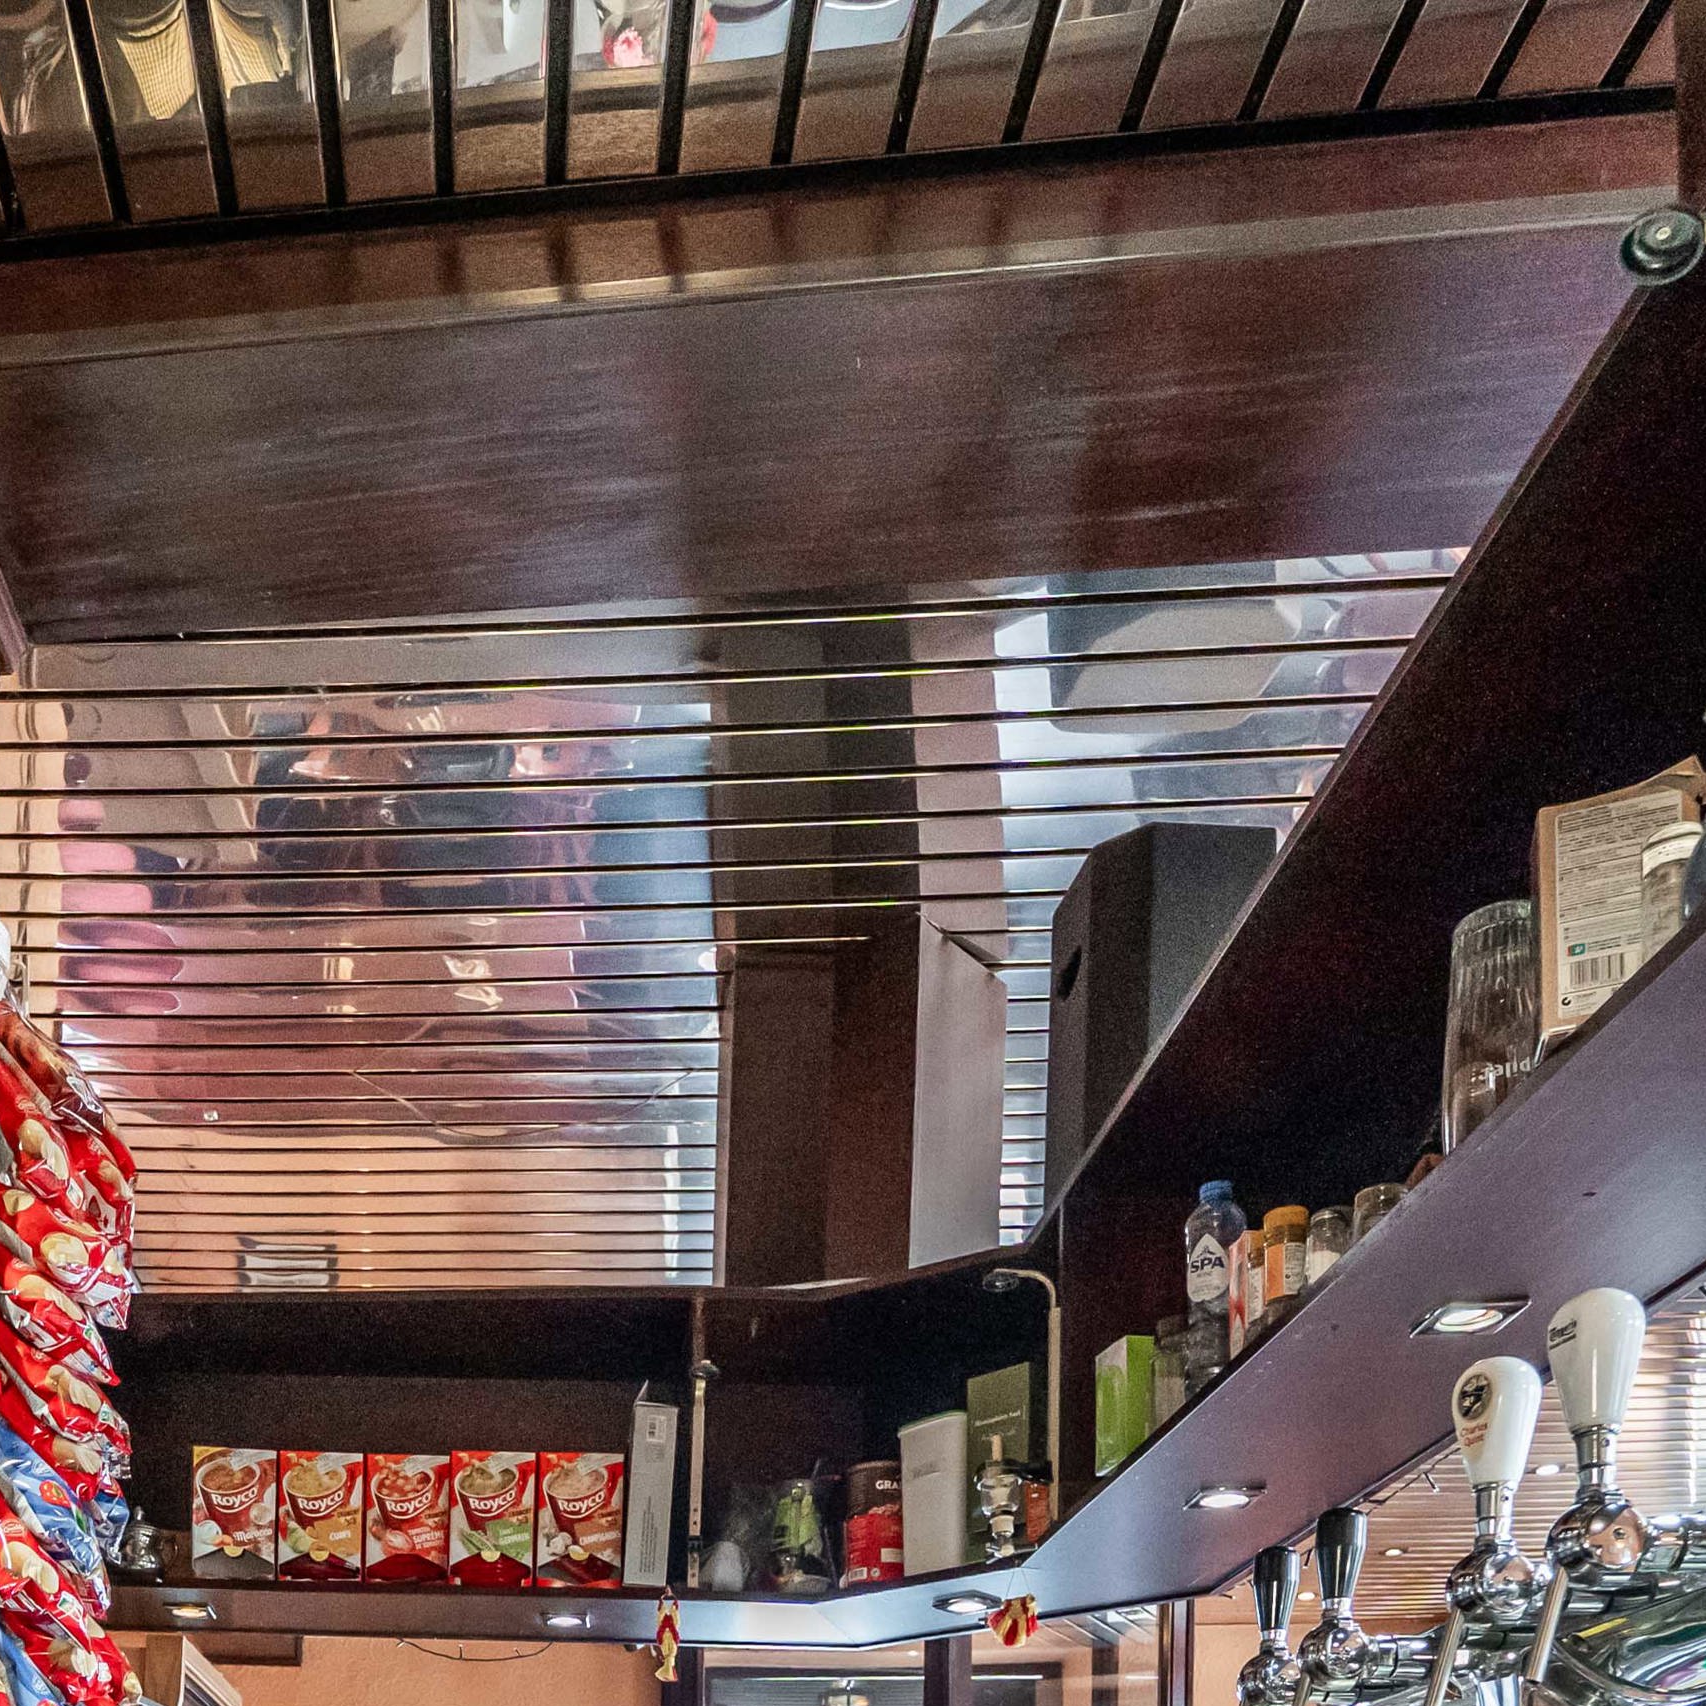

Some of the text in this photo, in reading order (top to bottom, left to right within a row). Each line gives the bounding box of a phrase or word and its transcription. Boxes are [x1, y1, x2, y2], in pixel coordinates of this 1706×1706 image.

[1190, 1256, 1225, 1274] SPA
[875, 1480, 901, 1490] GRA
[211, 1487, 258, 1508] Royco
[297, 1490, 345, 1512] Royco
[385, 1493, 432, 1514] Royco
[468, 1490, 516, 1512] Royco
[558, 1491, 605, 1514] Royco
